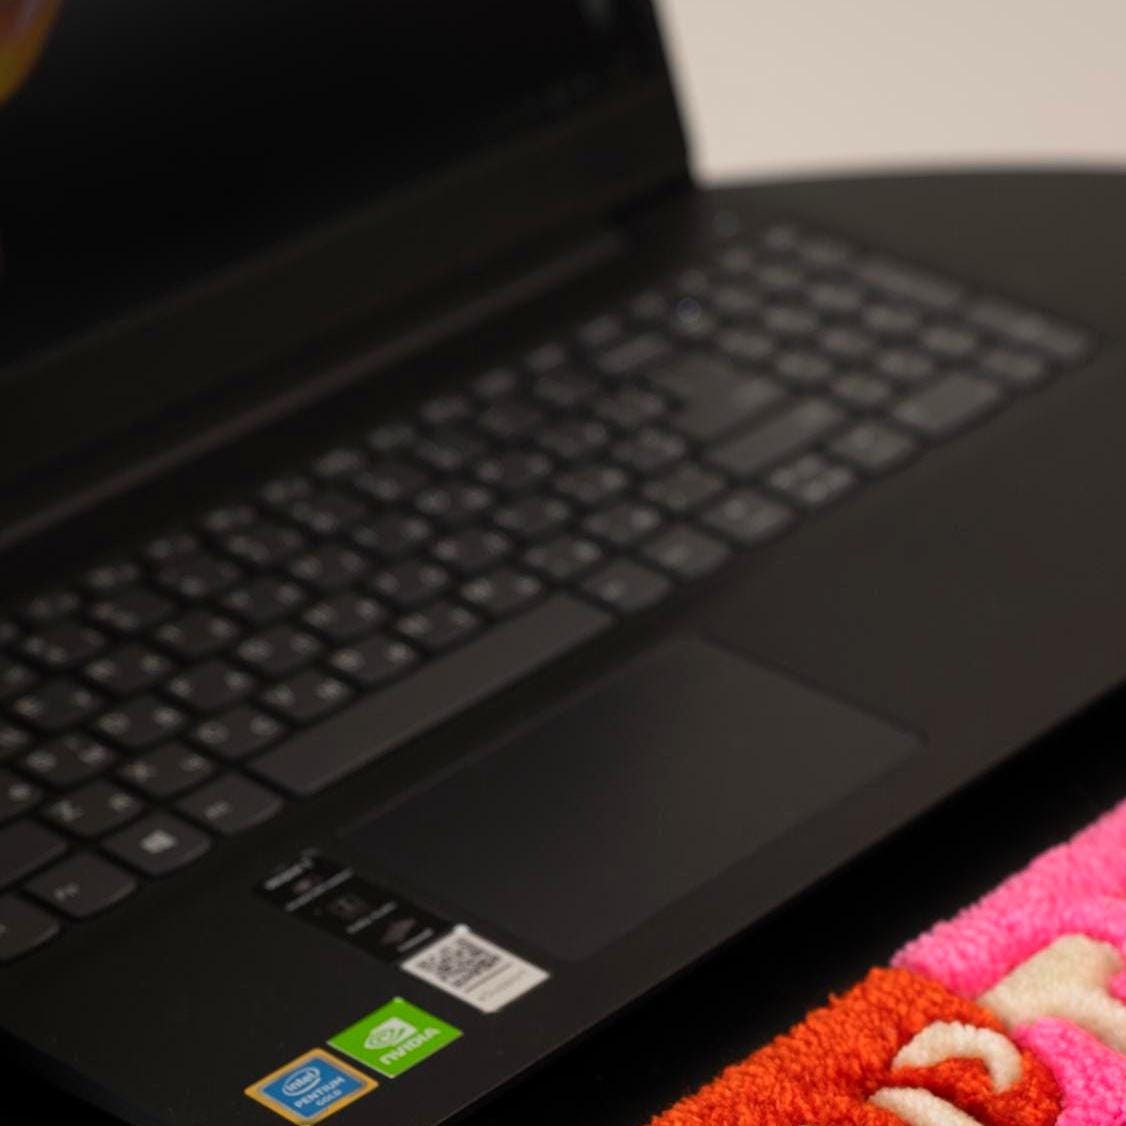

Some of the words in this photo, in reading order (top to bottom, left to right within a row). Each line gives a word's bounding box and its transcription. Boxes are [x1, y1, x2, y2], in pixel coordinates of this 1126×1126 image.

[379, 1027, 441, 1065] NVIDIA
[286, 1070, 318, 1092] intel
[294, 1076, 347, 1108] PENTIUM
